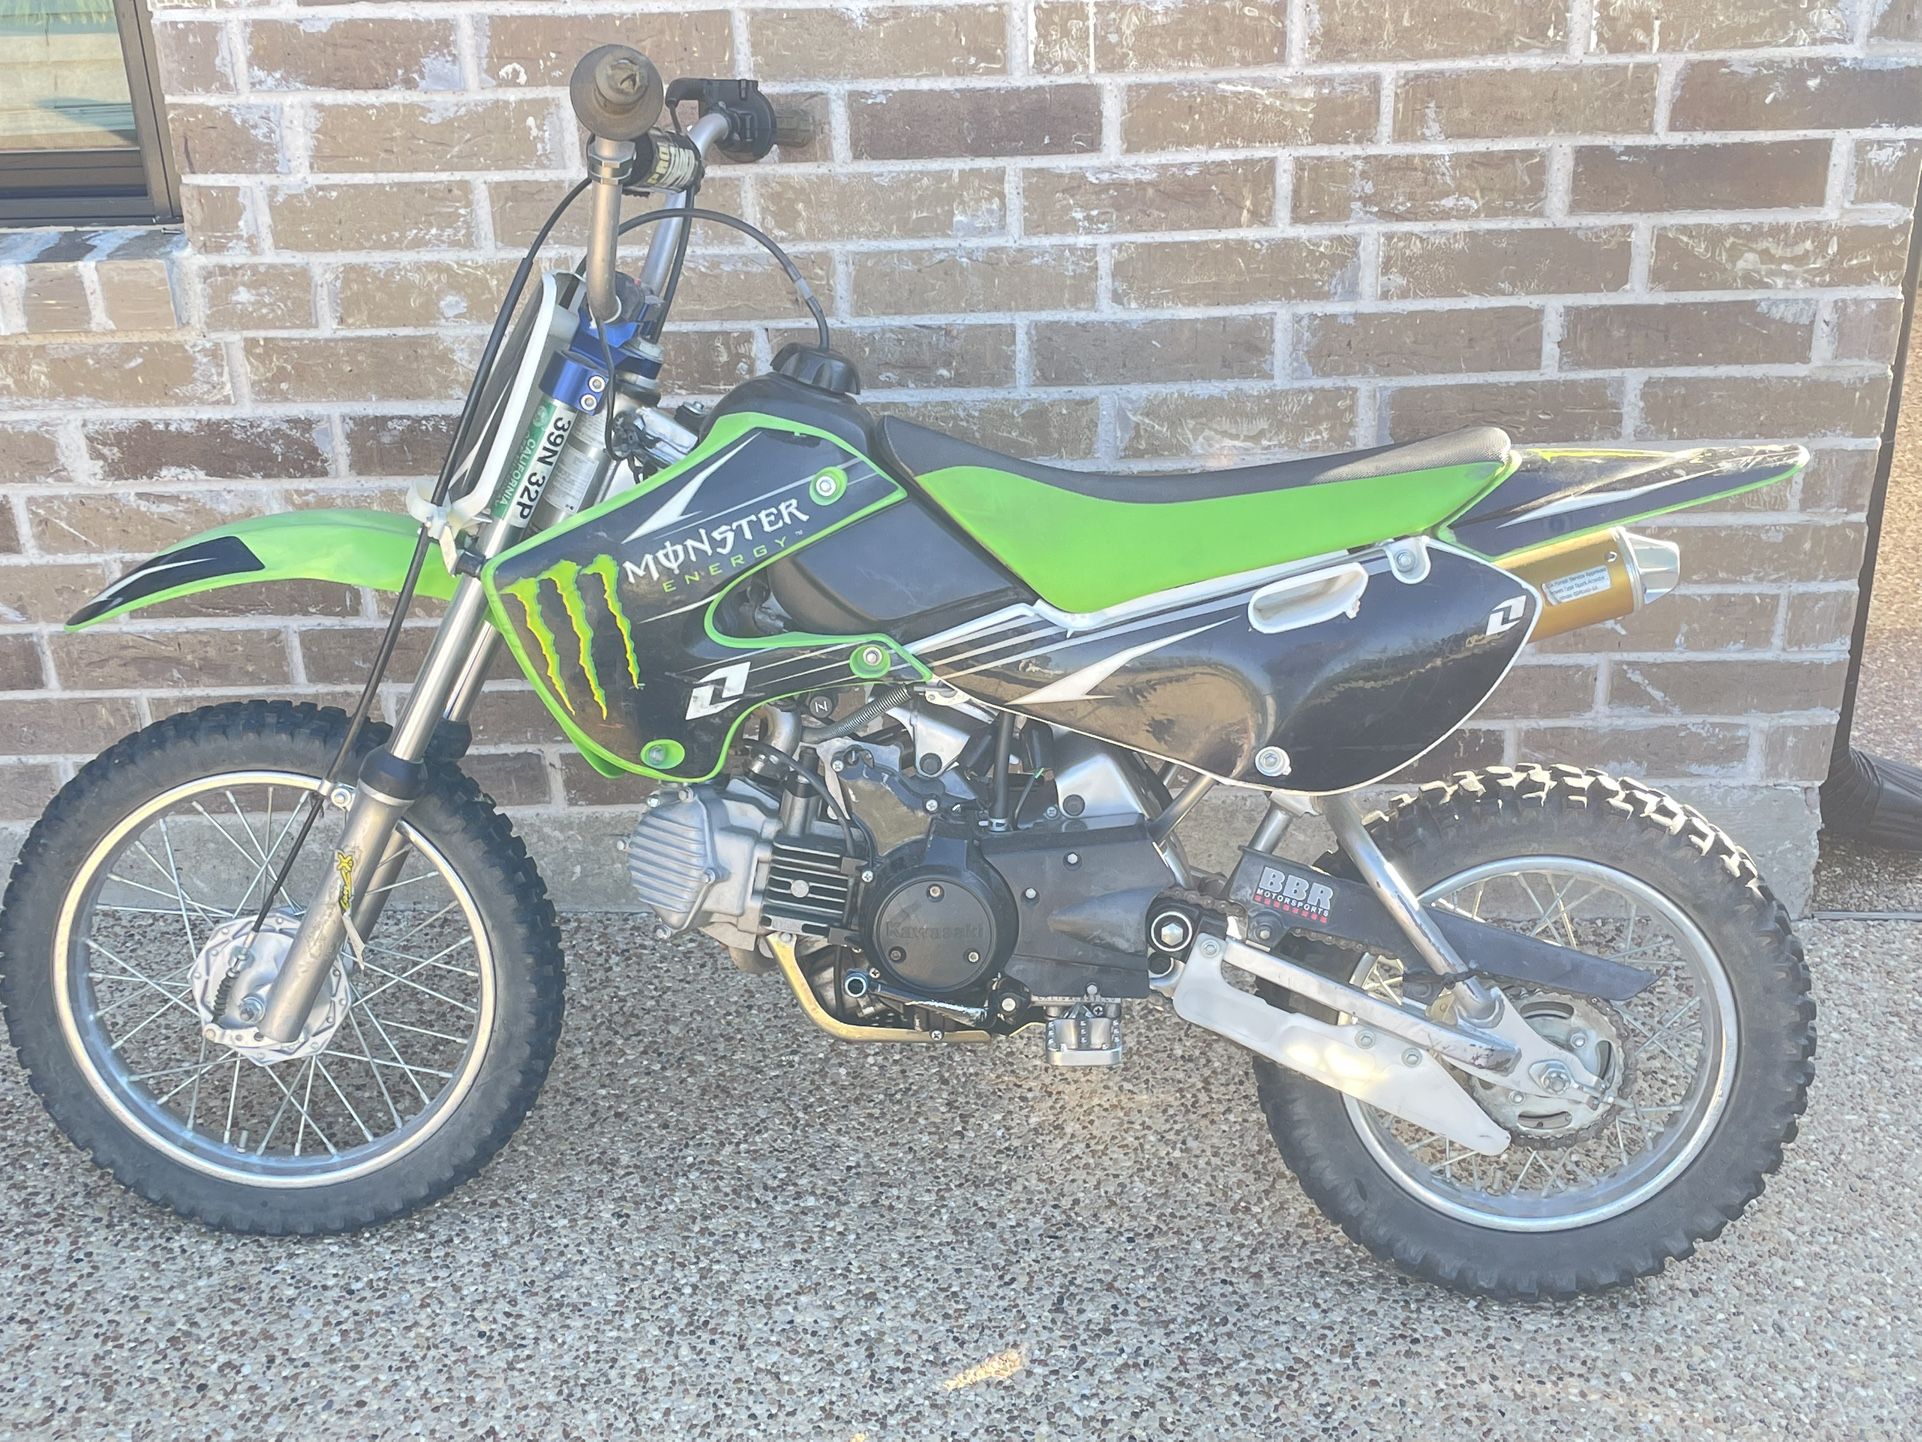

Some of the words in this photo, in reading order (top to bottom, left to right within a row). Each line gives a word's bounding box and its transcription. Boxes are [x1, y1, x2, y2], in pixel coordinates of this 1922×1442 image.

[537, 417, 571, 467] 39N
[500, 439, 535, 505] CALIFORNIA
[517, 472, 546, 520] 32P
[622, 498, 810, 584] MONSTER
[662, 536, 787, 593] ENERGY
[1255, 888, 1329, 917] MOTORSPORTS
[1258, 866, 1334, 910] BBR
[886, 920, 985, 940] Kawasaki
